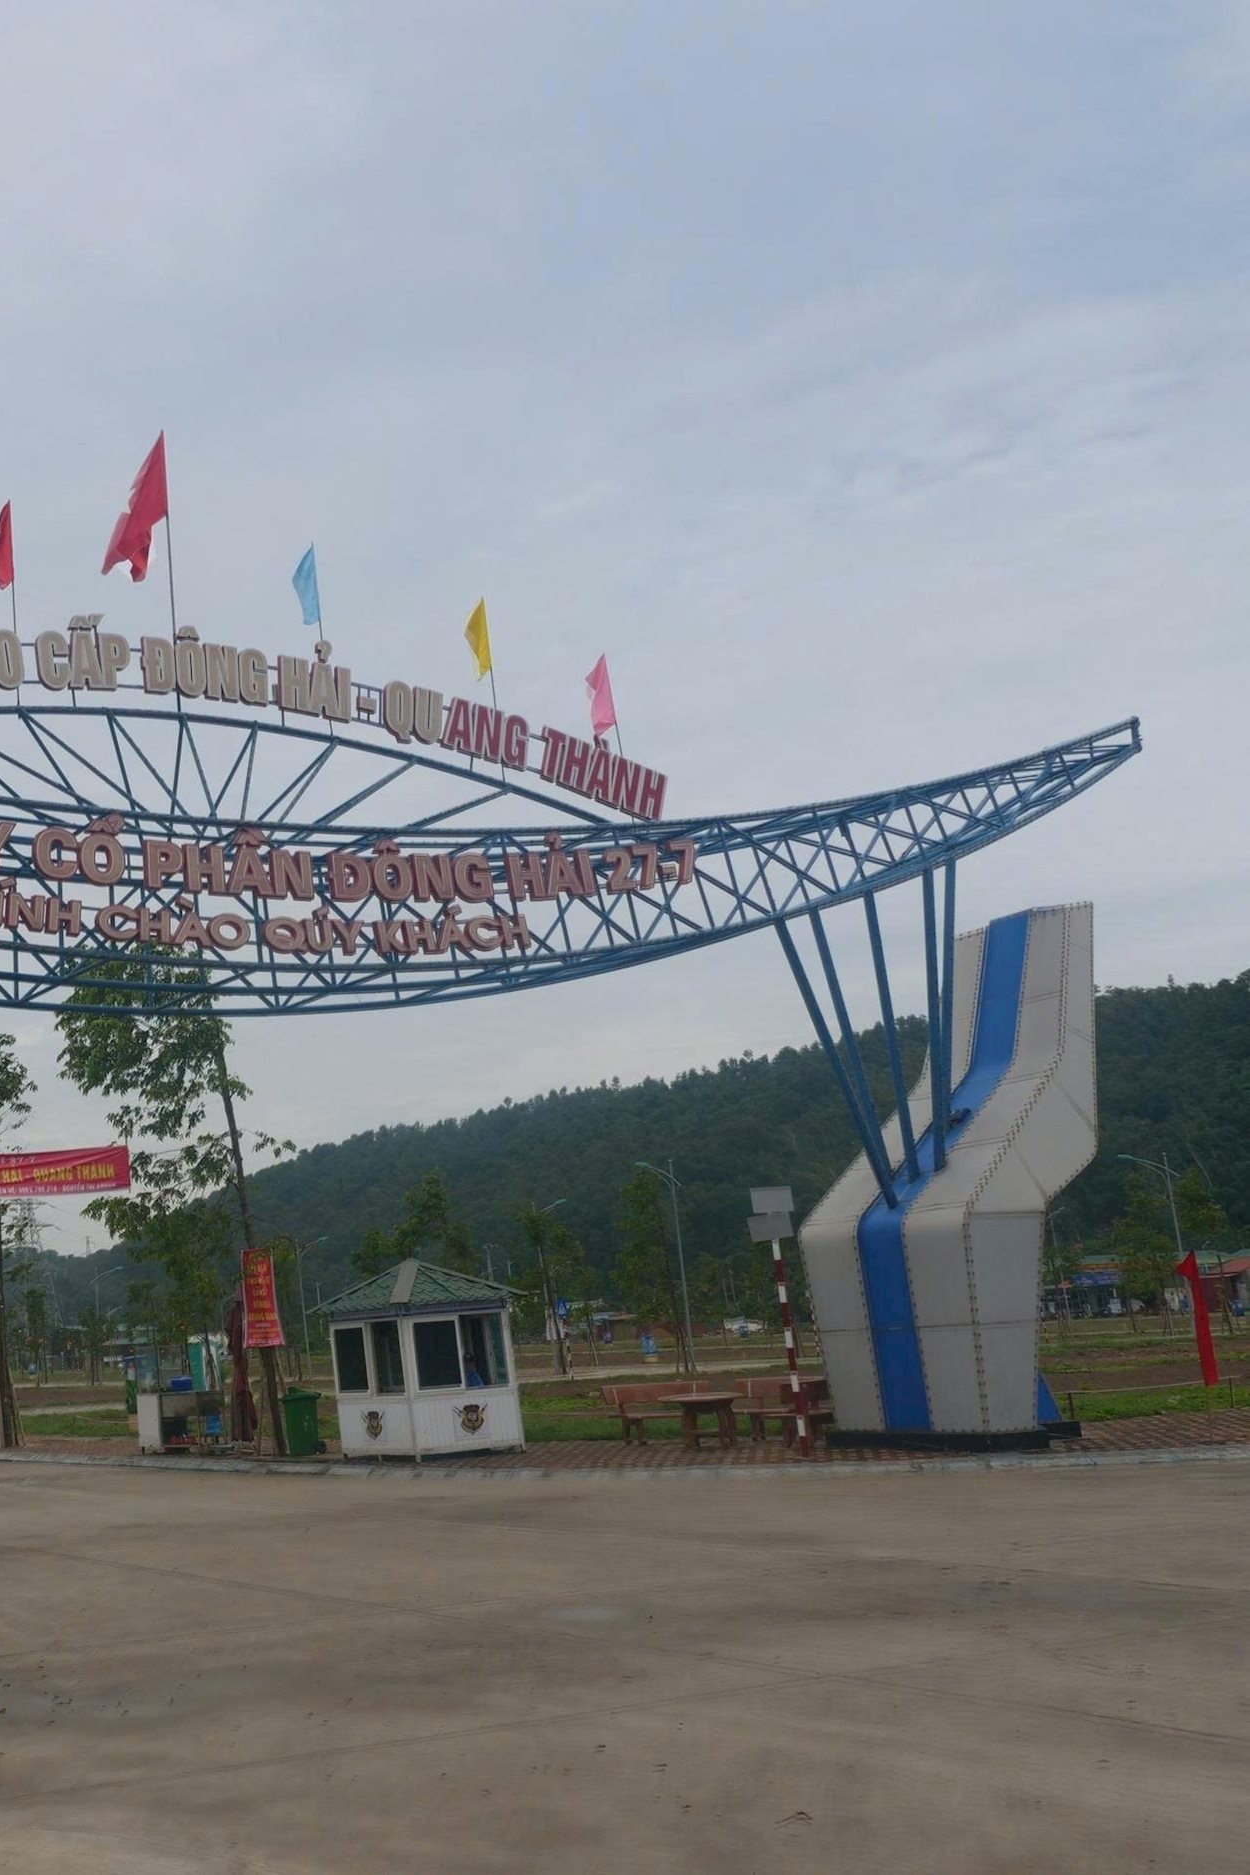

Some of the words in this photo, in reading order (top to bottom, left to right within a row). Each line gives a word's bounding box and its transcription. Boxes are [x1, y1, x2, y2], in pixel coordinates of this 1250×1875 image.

[35, 613, 131, 691] CẤP
[141, 625, 268, 707] ĐÔNG
[277, 640, 351, 723] HẢI
[383, 681, 529, 771] QUANG
[540, 726, 668, 822] THÀNH
[326, 838, 495, 902] ĐÔNG
[505, 830, 597, 902] HẢI
[95, 896, 250, 951] CHÀO
[372, 905, 532, 955] KHÁCH
